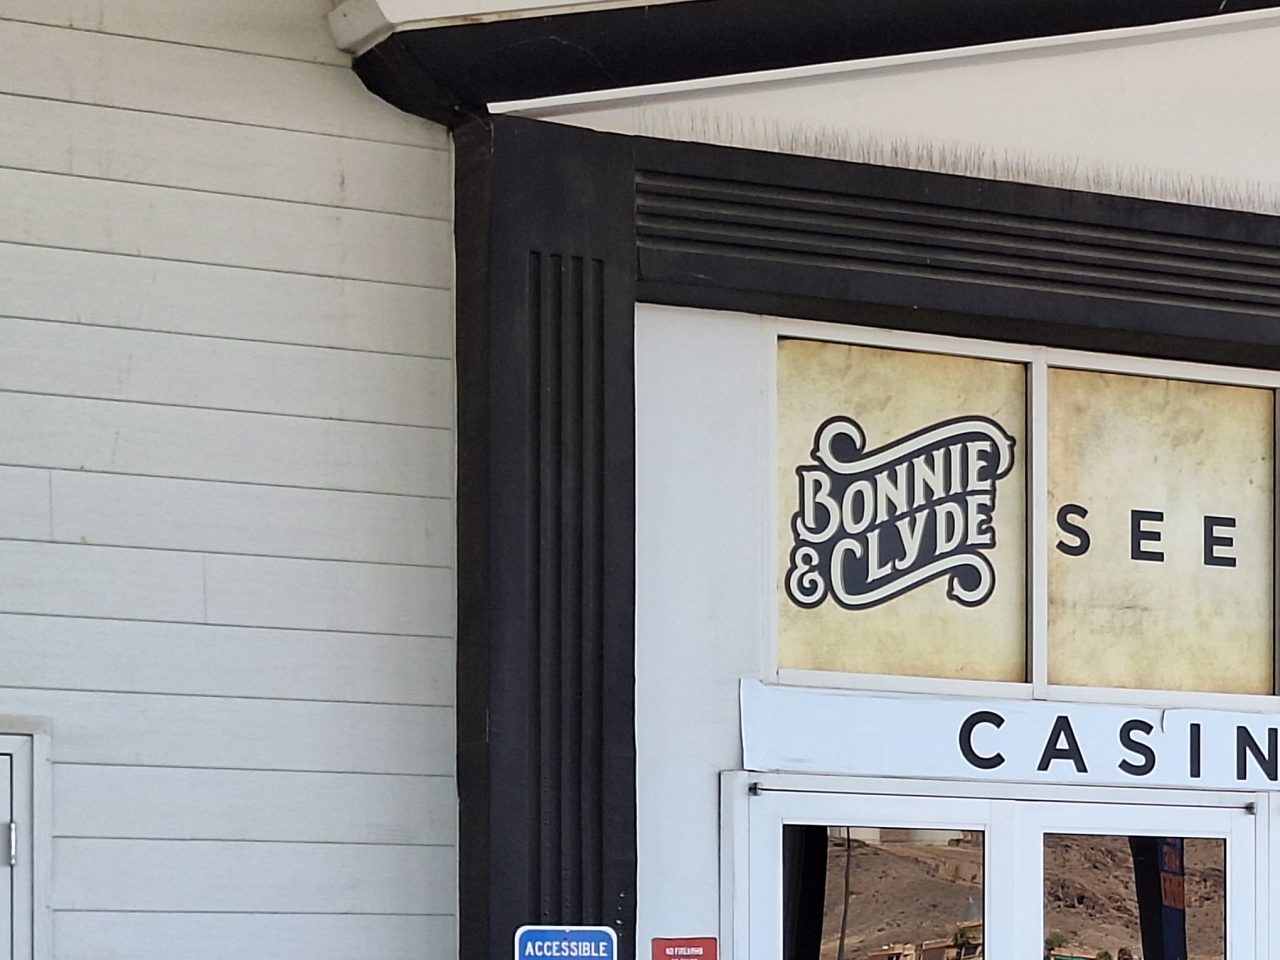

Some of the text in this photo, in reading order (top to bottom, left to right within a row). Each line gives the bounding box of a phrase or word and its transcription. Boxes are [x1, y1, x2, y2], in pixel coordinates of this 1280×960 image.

[796, 440, 993, 543] BONNIE
[830, 494, 993, 606] CLYDE
[1055, 503, 1237, 568] SEE
[525, 941, 608, 957] ACCESSIBLE
